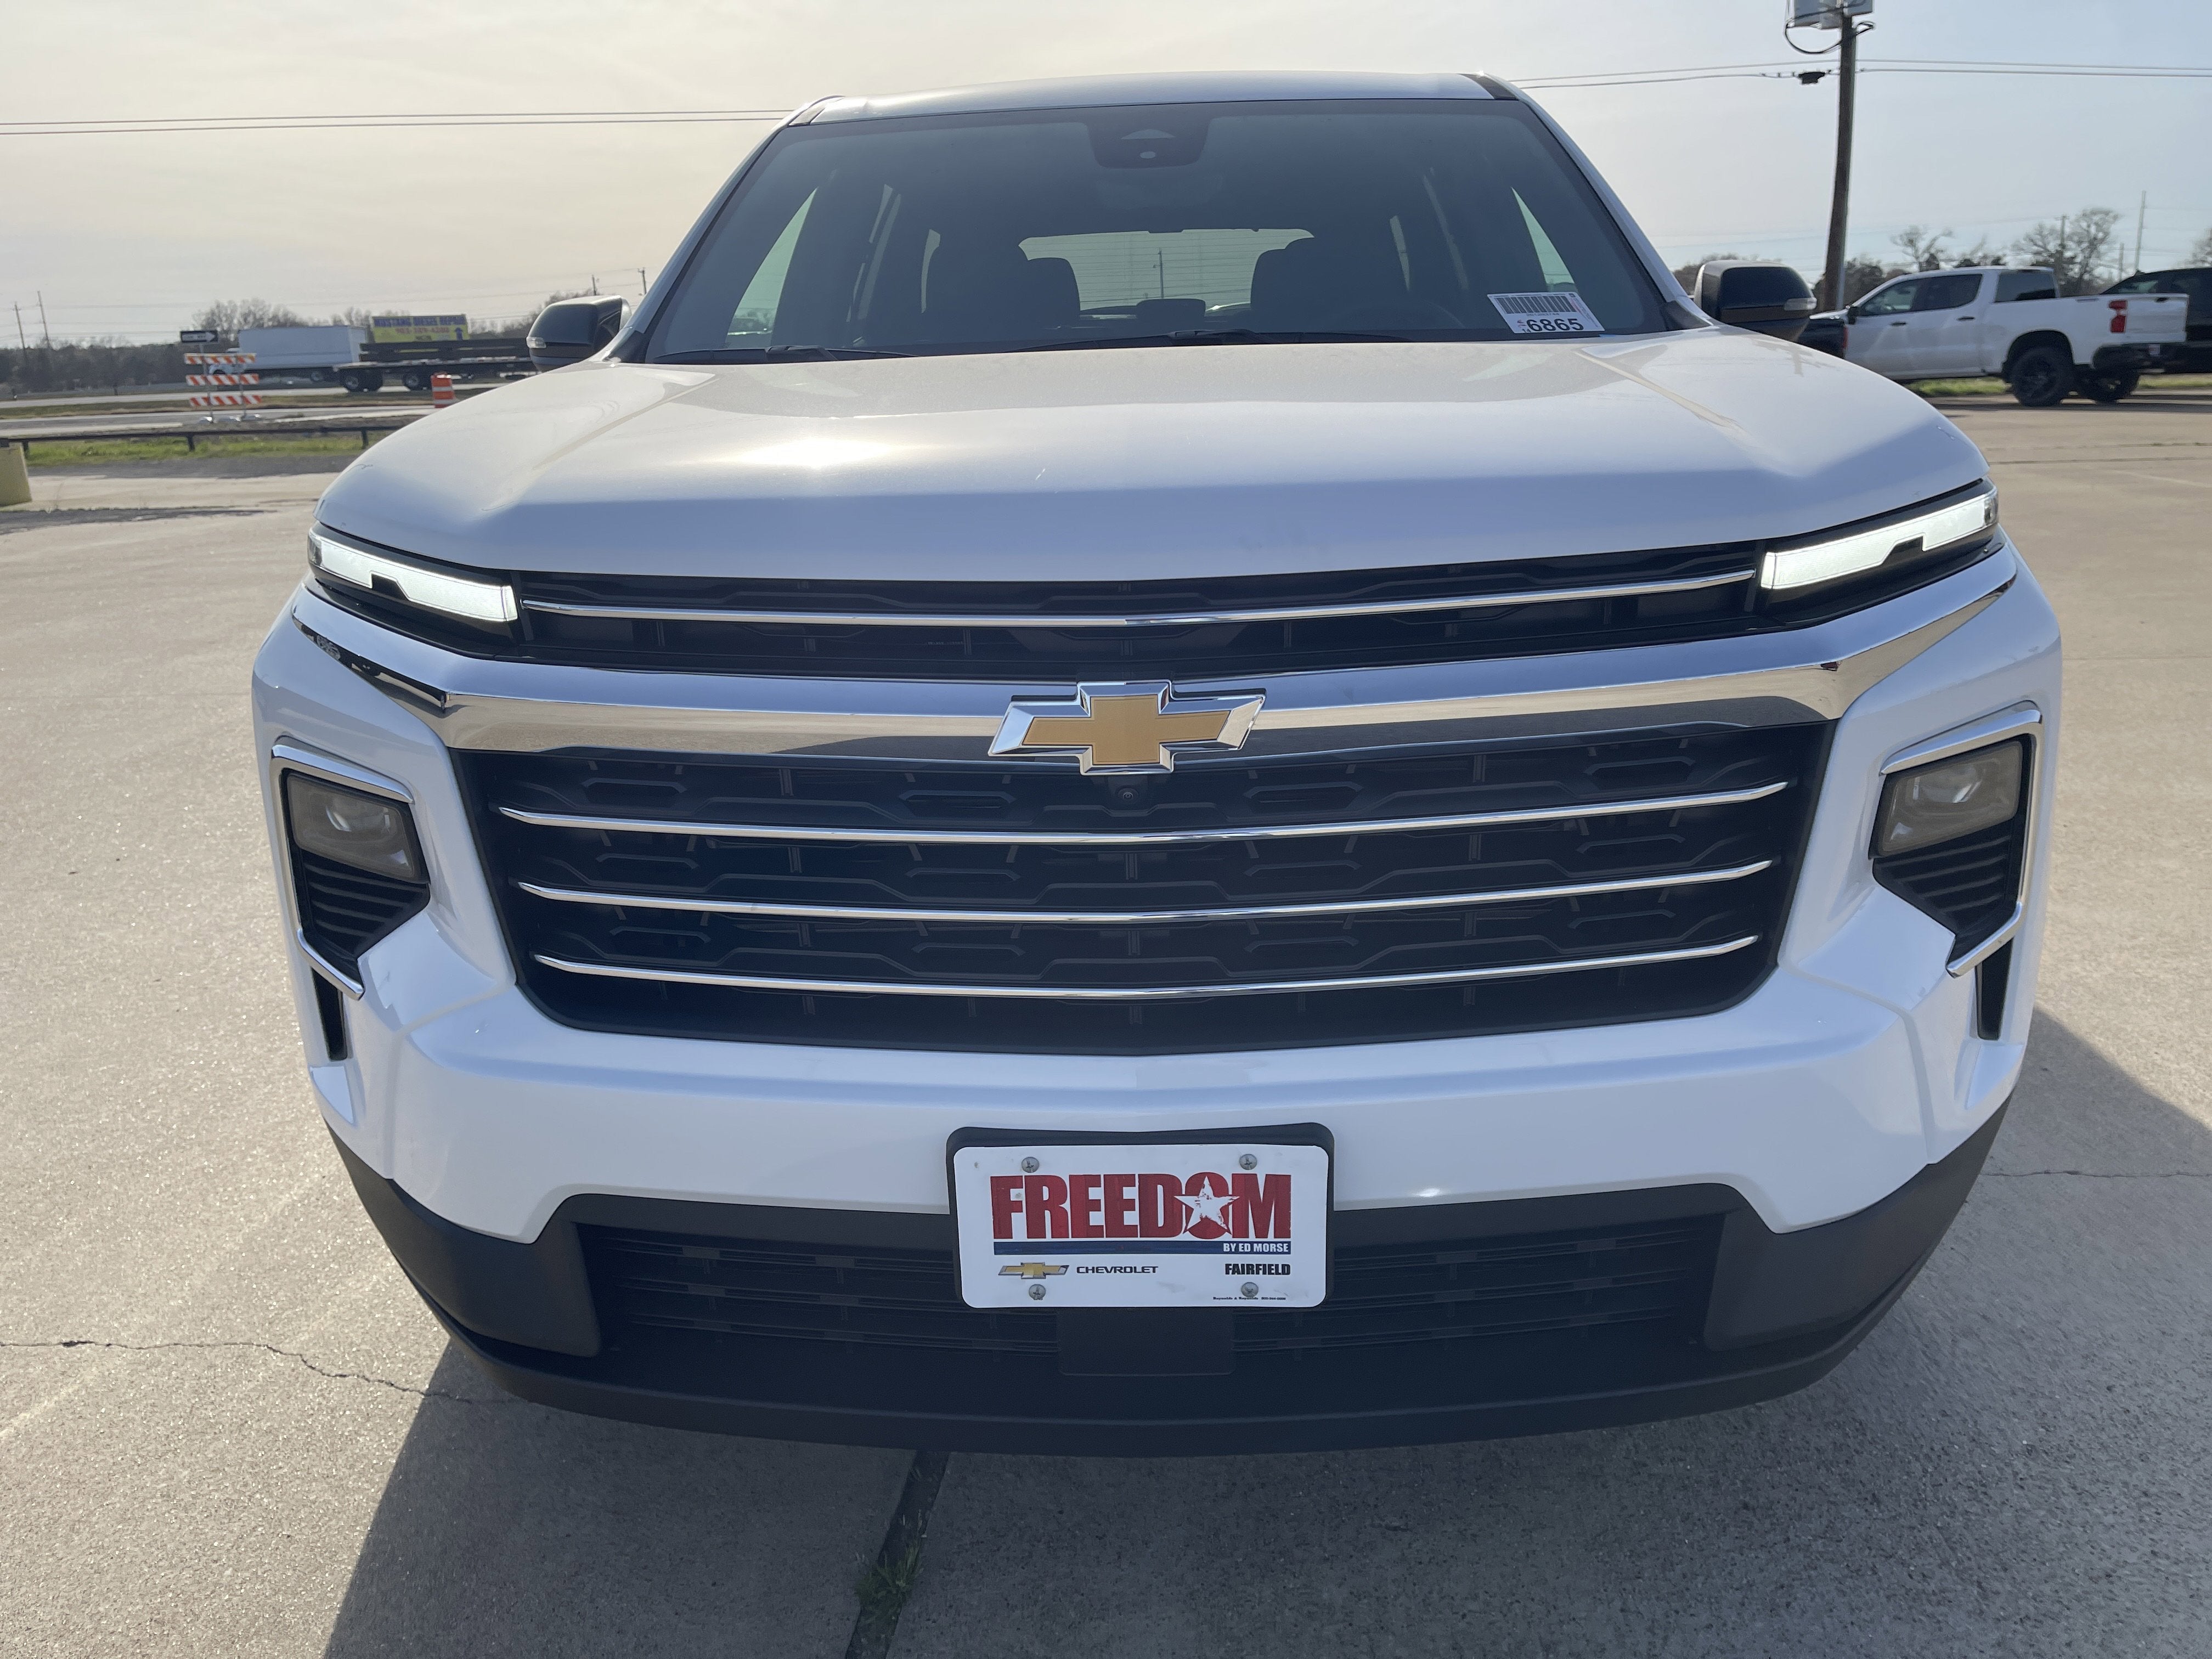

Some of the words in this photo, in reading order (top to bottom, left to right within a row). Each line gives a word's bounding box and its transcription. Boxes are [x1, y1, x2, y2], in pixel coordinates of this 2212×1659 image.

[1526, 318, 1584, 332] 6865
[990, 1172, 1291, 1239] FREEDOM
[1223, 1243, 1237, 1252] BY
[1239, 1243, 1251, 1252] ED
[1253, 1243, 1289, 1252] MORSE
[1076, 1266, 1158, 1274] CHEVROLET
[1225, 1263, 1291, 1276] FAIRFIELD
